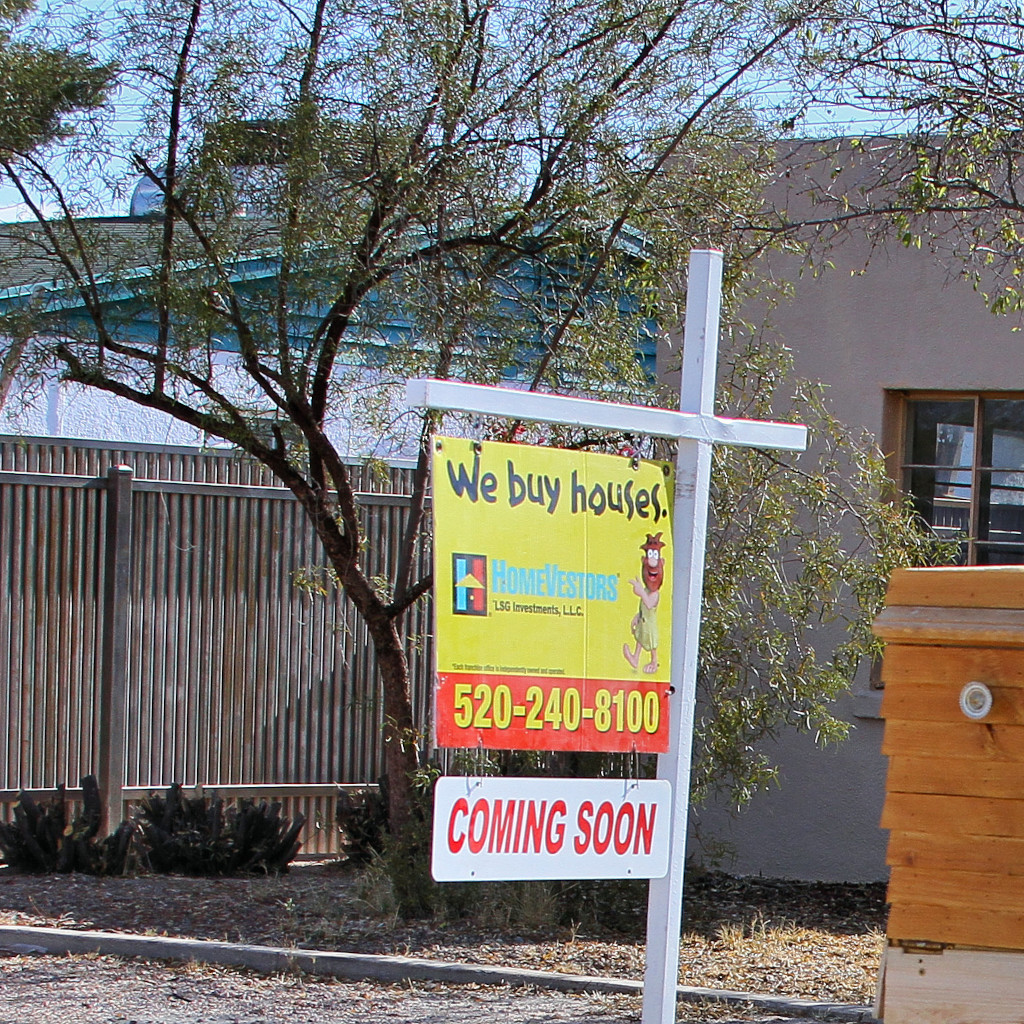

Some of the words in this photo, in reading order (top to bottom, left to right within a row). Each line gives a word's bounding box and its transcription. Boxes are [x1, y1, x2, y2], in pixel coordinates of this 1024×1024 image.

[447, 456, 498, 504] We
[507, 460, 561, 515] buy
[571, 469, 668, 523] houses.
[512, 601, 562, 617] Investments,
[562, 604, 585, 617] L.L.C.
[453, 683, 660, 734] 520-240-8100
[447, 797, 568, 855] COMING
[573, 799, 658, 855] SOON
